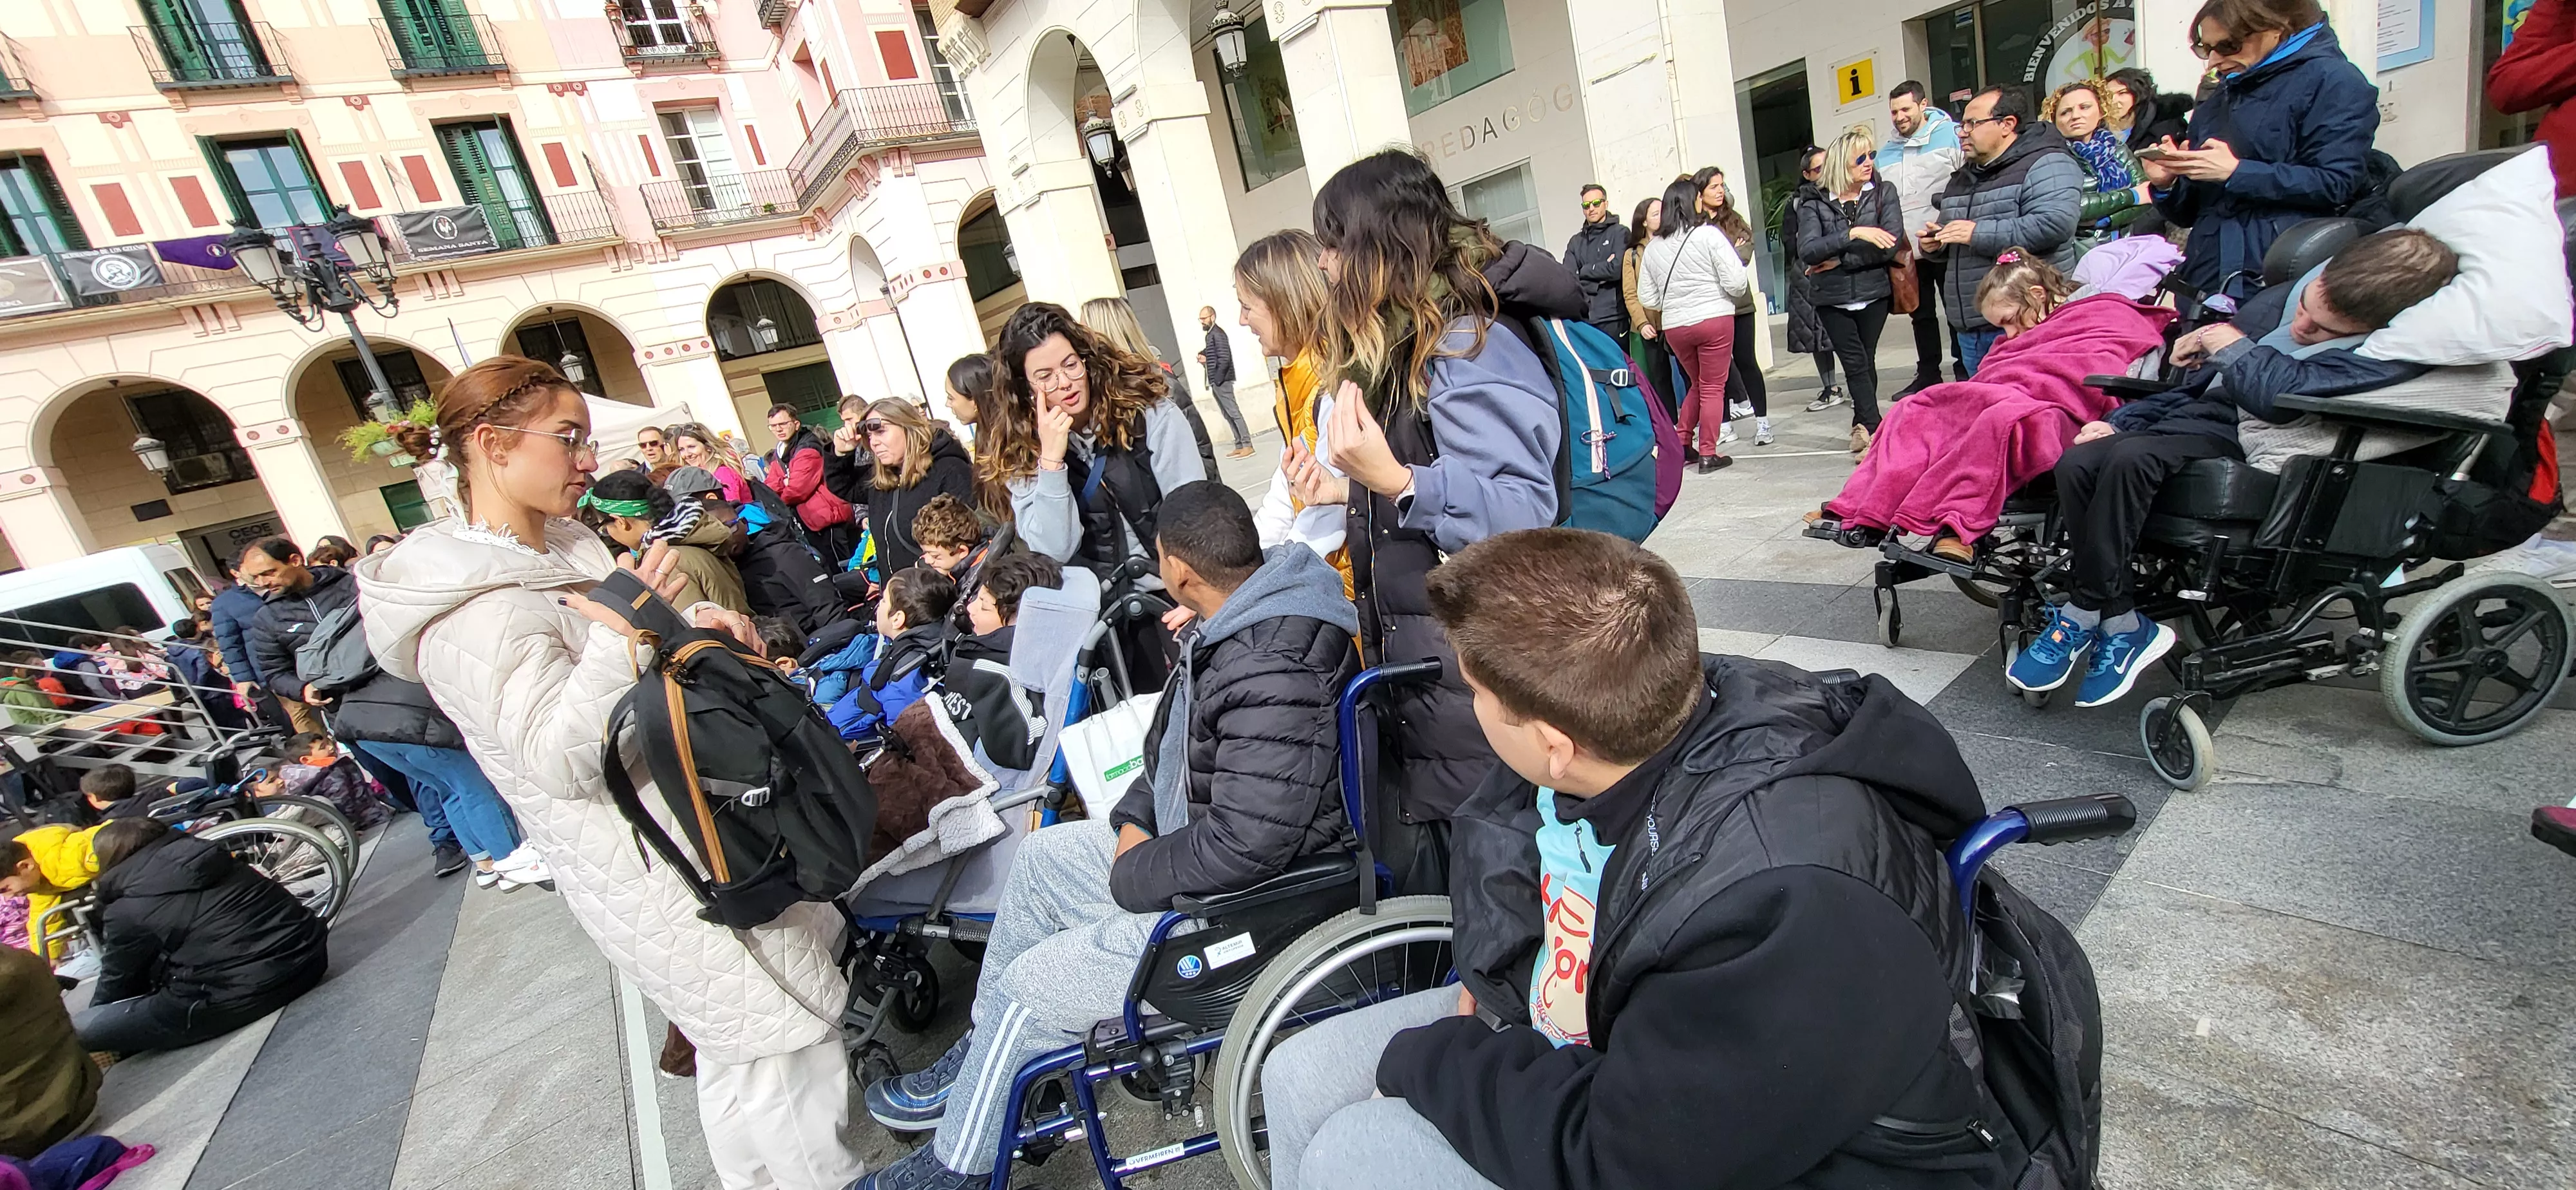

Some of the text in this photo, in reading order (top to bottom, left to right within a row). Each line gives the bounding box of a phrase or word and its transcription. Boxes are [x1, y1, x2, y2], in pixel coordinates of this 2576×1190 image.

[2022, 0, 2110, 82] BIENVENIDOS
[417, 240, 489, 253] SEMANA SANTA
[229, 522, 272, 539] CEOE
[1135, 1148, 1174, 1164] VERMEIREN
